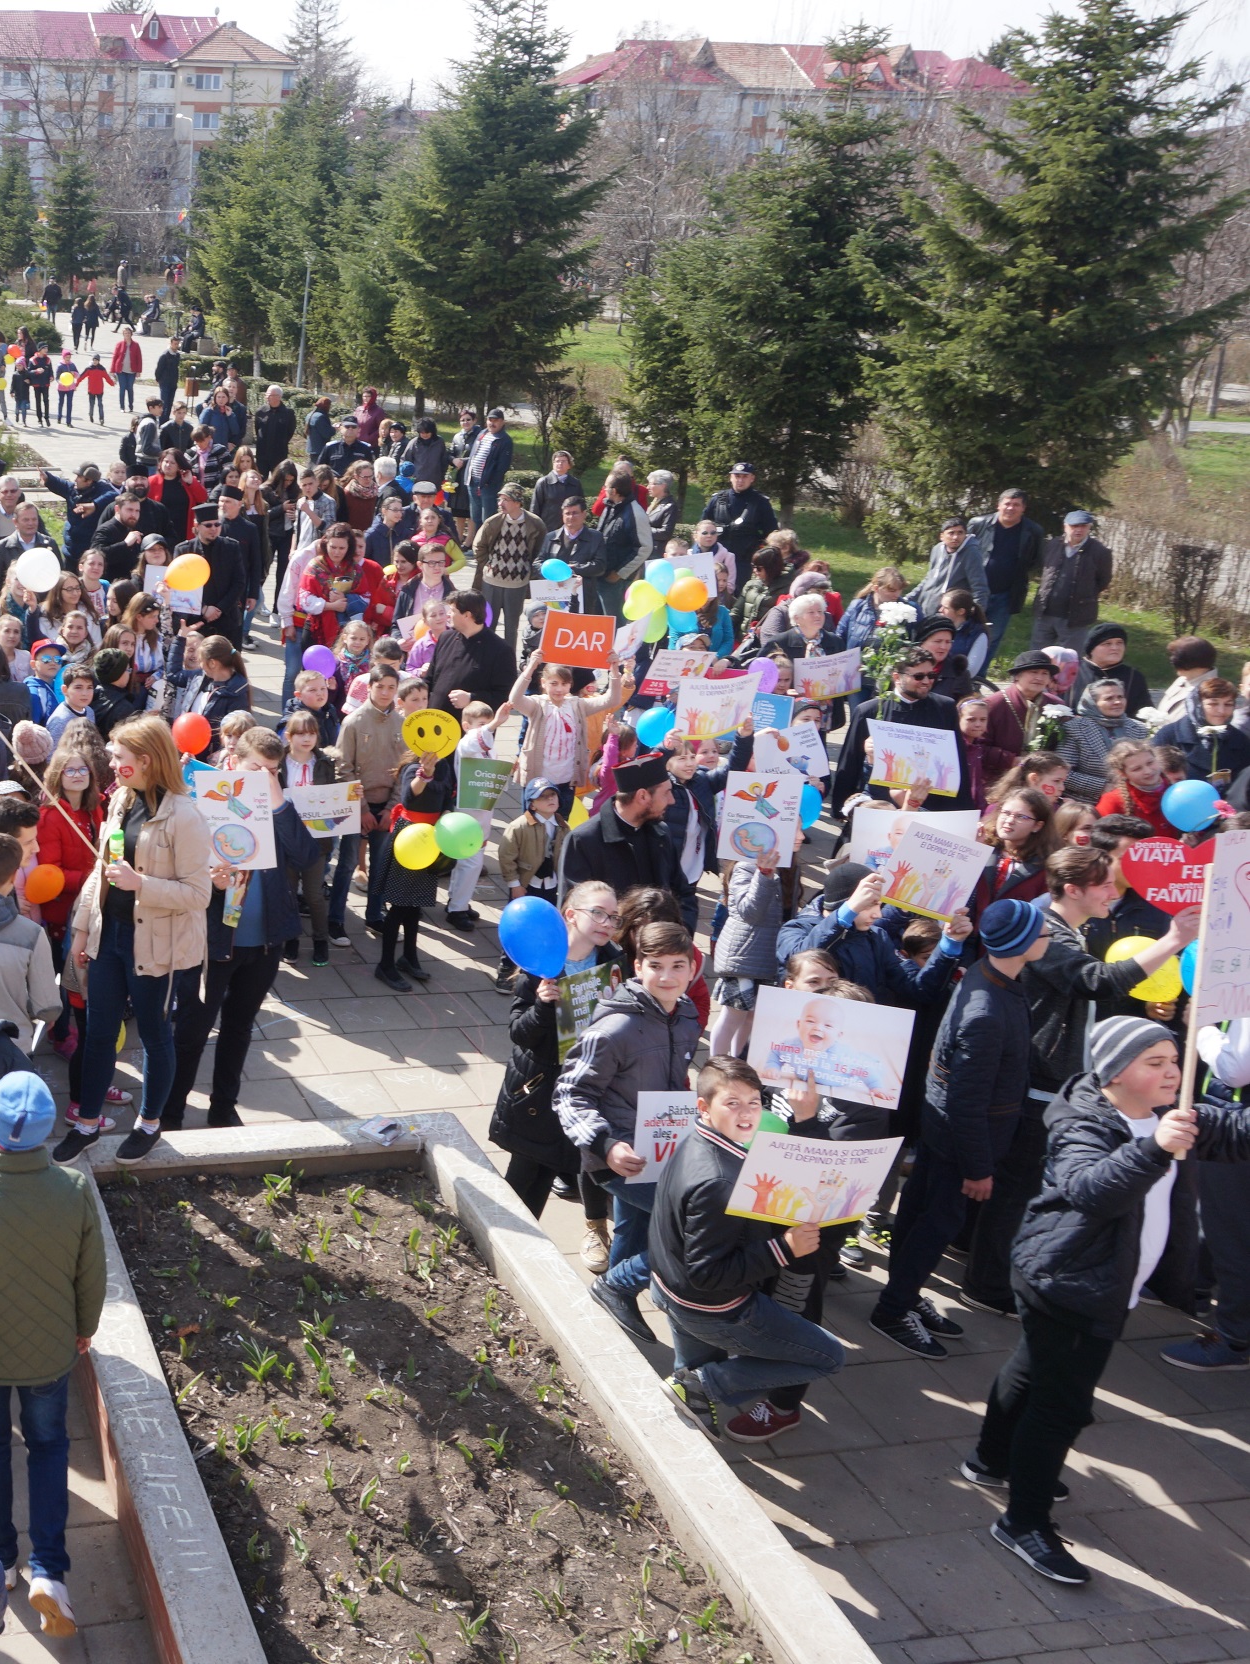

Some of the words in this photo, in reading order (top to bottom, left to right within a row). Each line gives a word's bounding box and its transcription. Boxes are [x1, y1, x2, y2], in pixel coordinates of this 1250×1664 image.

[554, 628, 606, 652] DAR
[474, 770, 496, 779] Orice
[468, 779, 495, 788] merită
[1135, 841, 1172, 849] pentru
[1129, 845, 1185, 866] VIAȚĂ
[1146, 888, 1205, 903] FAMIL
[570, 976, 601, 994] Femeile
[574, 1004, 590, 1018] mai
[575, 1014, 592, 1027] mul
[770, 1042, 801, 1054] Inima
[803, 1049, 828, 1060] mea
[779, 1054, 791, 1064] să
[794, 1055, 819, 1068] bată
[821, 1061, 831, 1070] la
[834, 1063, 848, 1074] 16
[850, 1068, 869, 1078] zile
[797, 1066, 808, 1076] la
[814, 1070, 864, 1087] oncepție
[653, 1128, 672, 1140] aleg
[769, 1141, 801, 1152] AJUTĂ
[804, 1146, 839, 1157] MAMA
[784, 1152, 793, 1160] EI
[795, 1154, 833, 1165] DEPIND
[835, 1158, 848, 1166] DE
